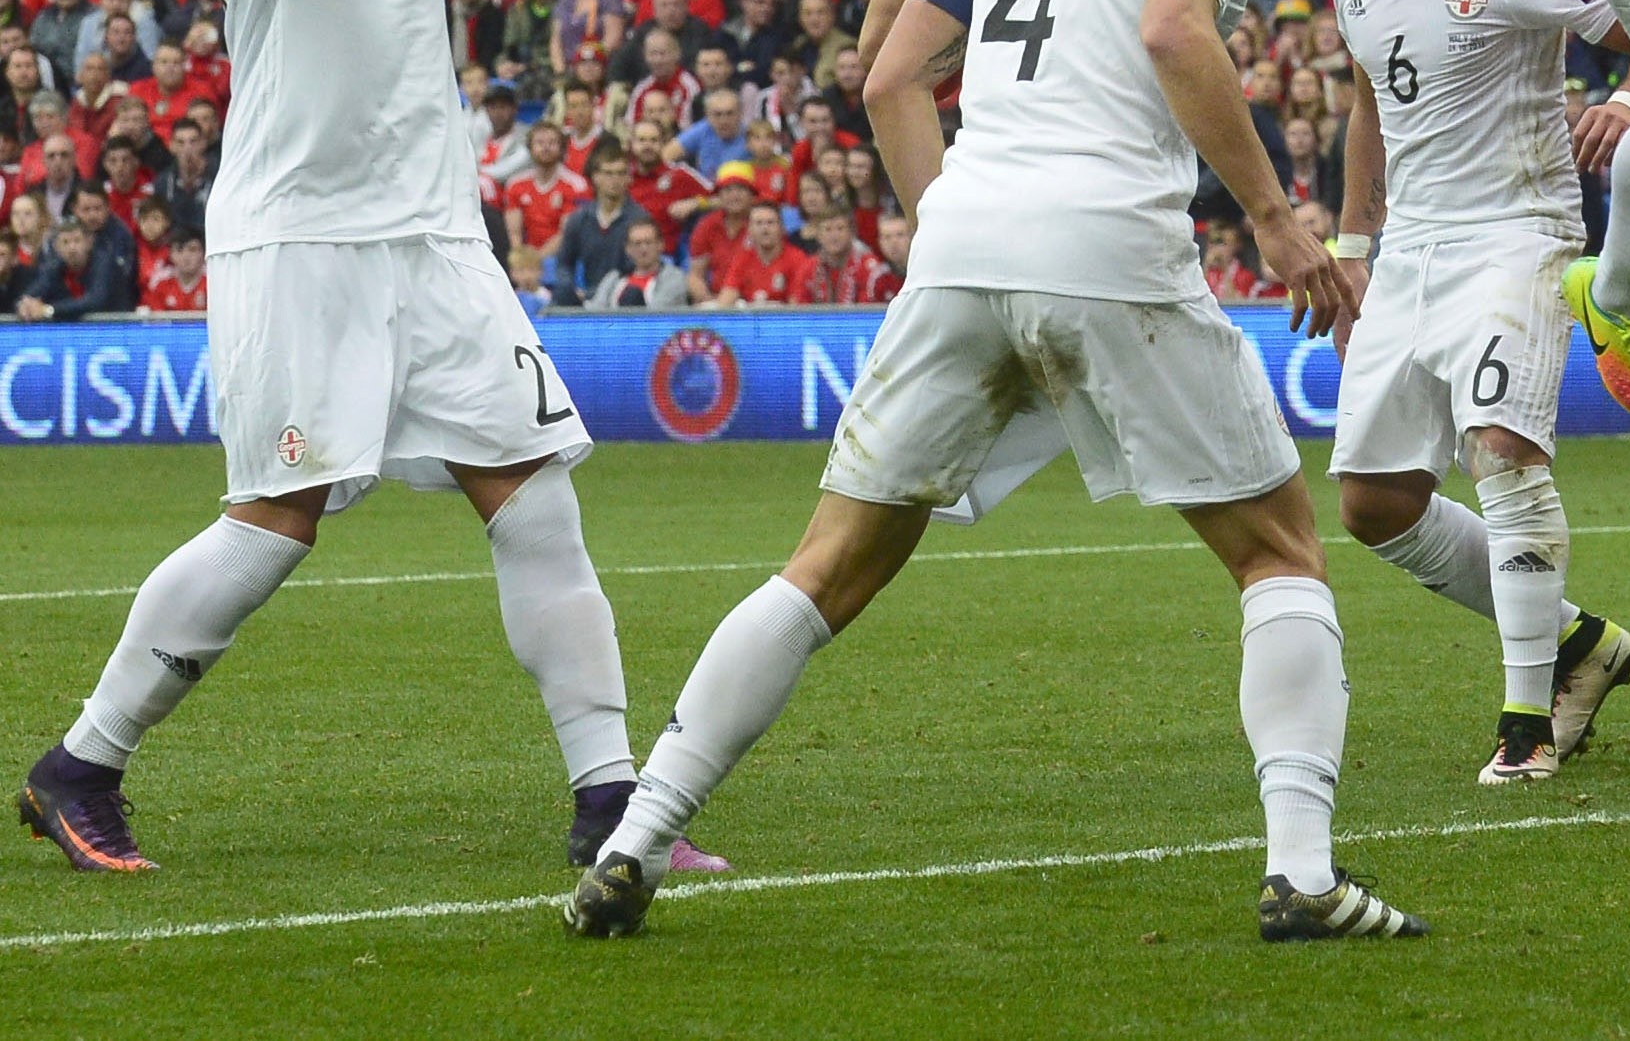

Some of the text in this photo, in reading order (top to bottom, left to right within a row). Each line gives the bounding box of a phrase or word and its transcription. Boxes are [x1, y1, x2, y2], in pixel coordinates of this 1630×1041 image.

[1388, 34, 1420, 104] 6
[0, 345, 219, 438] CISM
[515, 345, 575, 427] 2
[802, 336, 869, 431] N
[1472, 335, 1509, 407] 6
[1498, 564, 1556, 573] adidas
